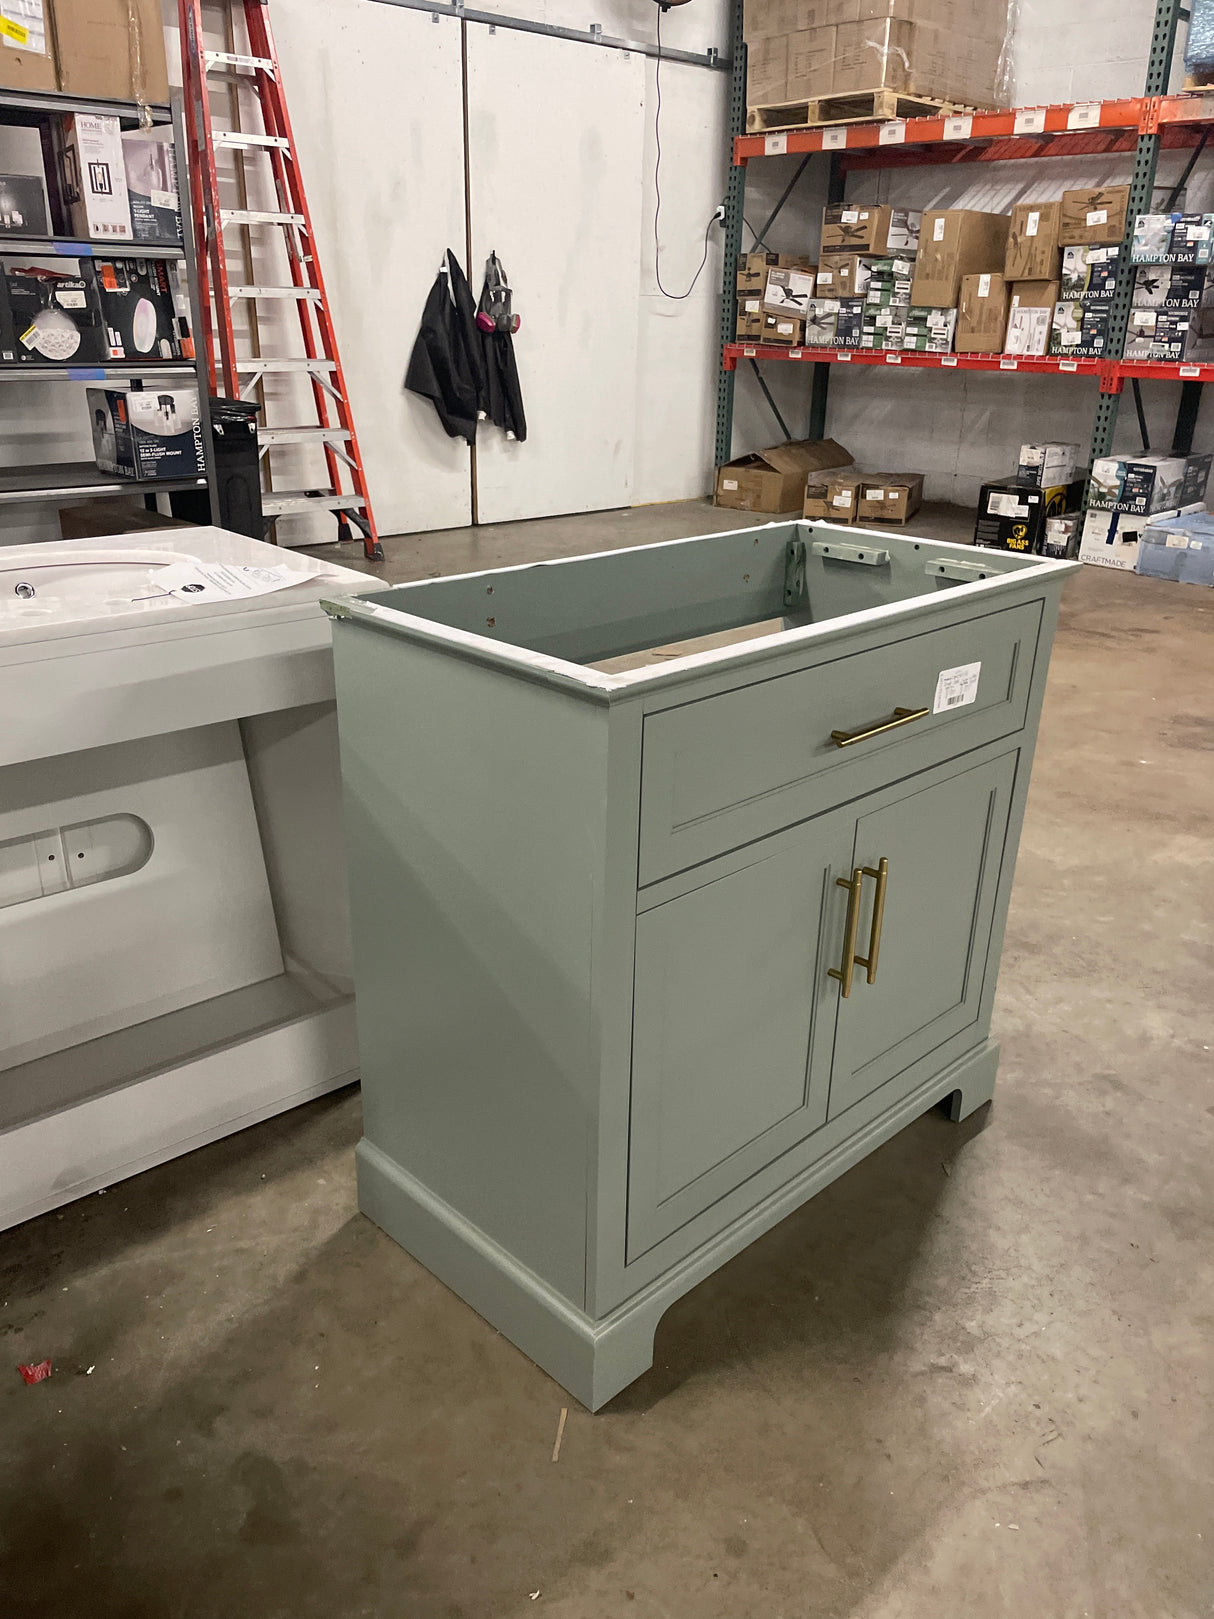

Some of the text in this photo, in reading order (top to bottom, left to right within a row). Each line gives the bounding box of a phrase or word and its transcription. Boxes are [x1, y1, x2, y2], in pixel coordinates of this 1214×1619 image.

[1132, 253, 1195, 262] HAMPTON BAY
[1063, 290, 1115, 299] HAMPTON BAY
[1134, 298, 1199, 308] HAMPTON BAY
[808, 335, 860, 345] HAMPTON BAY
[1051, 346, 1103, 355] HAMPTON BAY
[1165, 351, 1181, 359] BAY
[192, 417, 206, 472] HAMPTON
[1089, 498, 1129, 511] HAMPTON
[1130, 504, 1146, 513] BAY
[1080, 554, 1127, 568] CRAFTMADE
